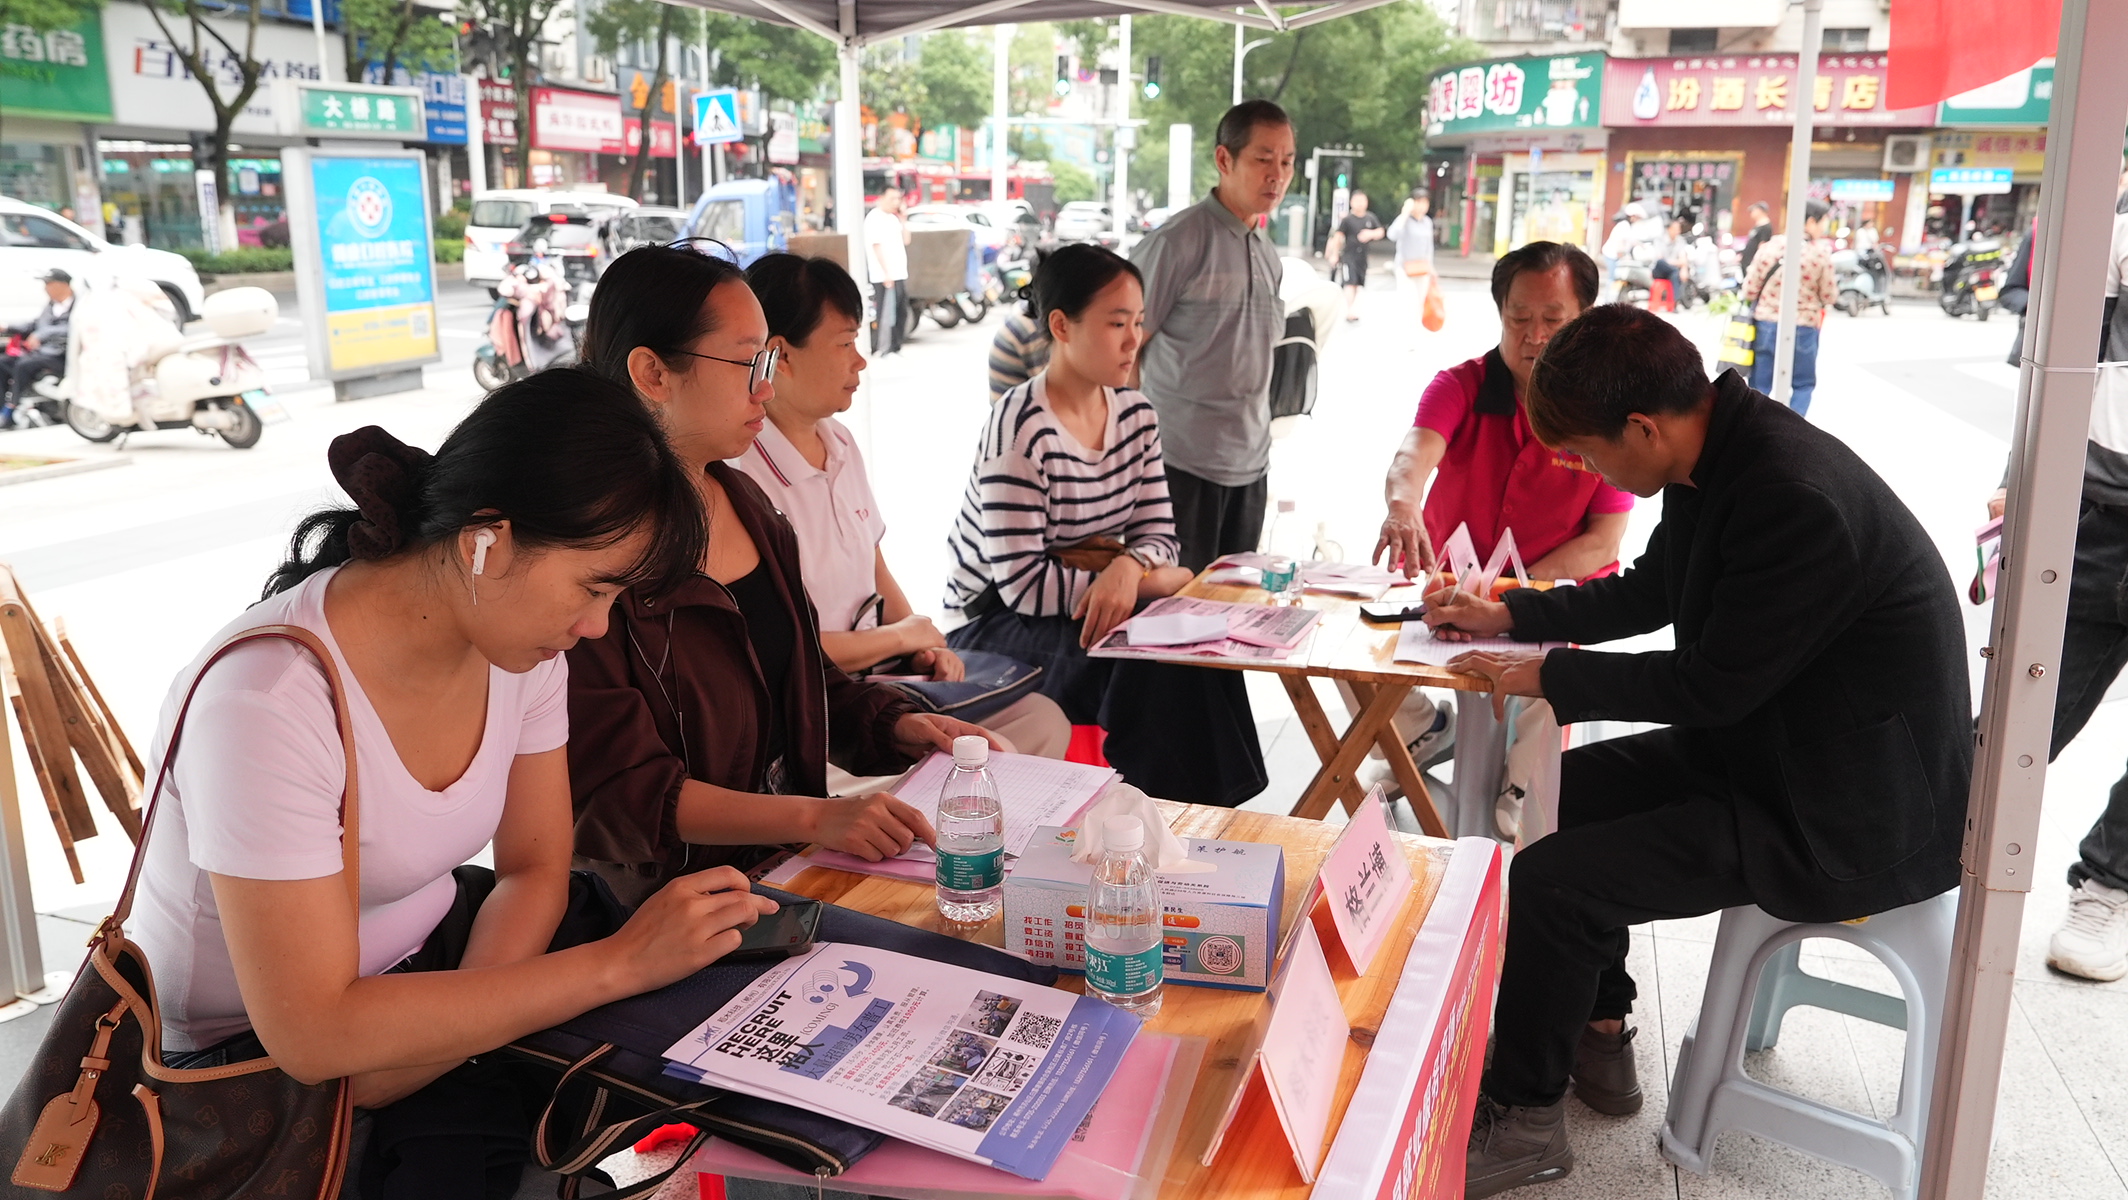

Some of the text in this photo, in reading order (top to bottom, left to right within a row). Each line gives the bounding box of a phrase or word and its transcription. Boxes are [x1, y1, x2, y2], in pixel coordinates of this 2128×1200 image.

[1024, 916, 1053, 926] 找工作
[1025, 938, 1055, 949] 办信访
[715, 990, 792, 1053] RECRUIT
[730, 1020, 784, 1058] HERE
[750, 1031, 800, 1062] 这里
[804, 1001, 890, 1079] 大量招聘男女普工
[775, 1042, 824, 1069] 招人
